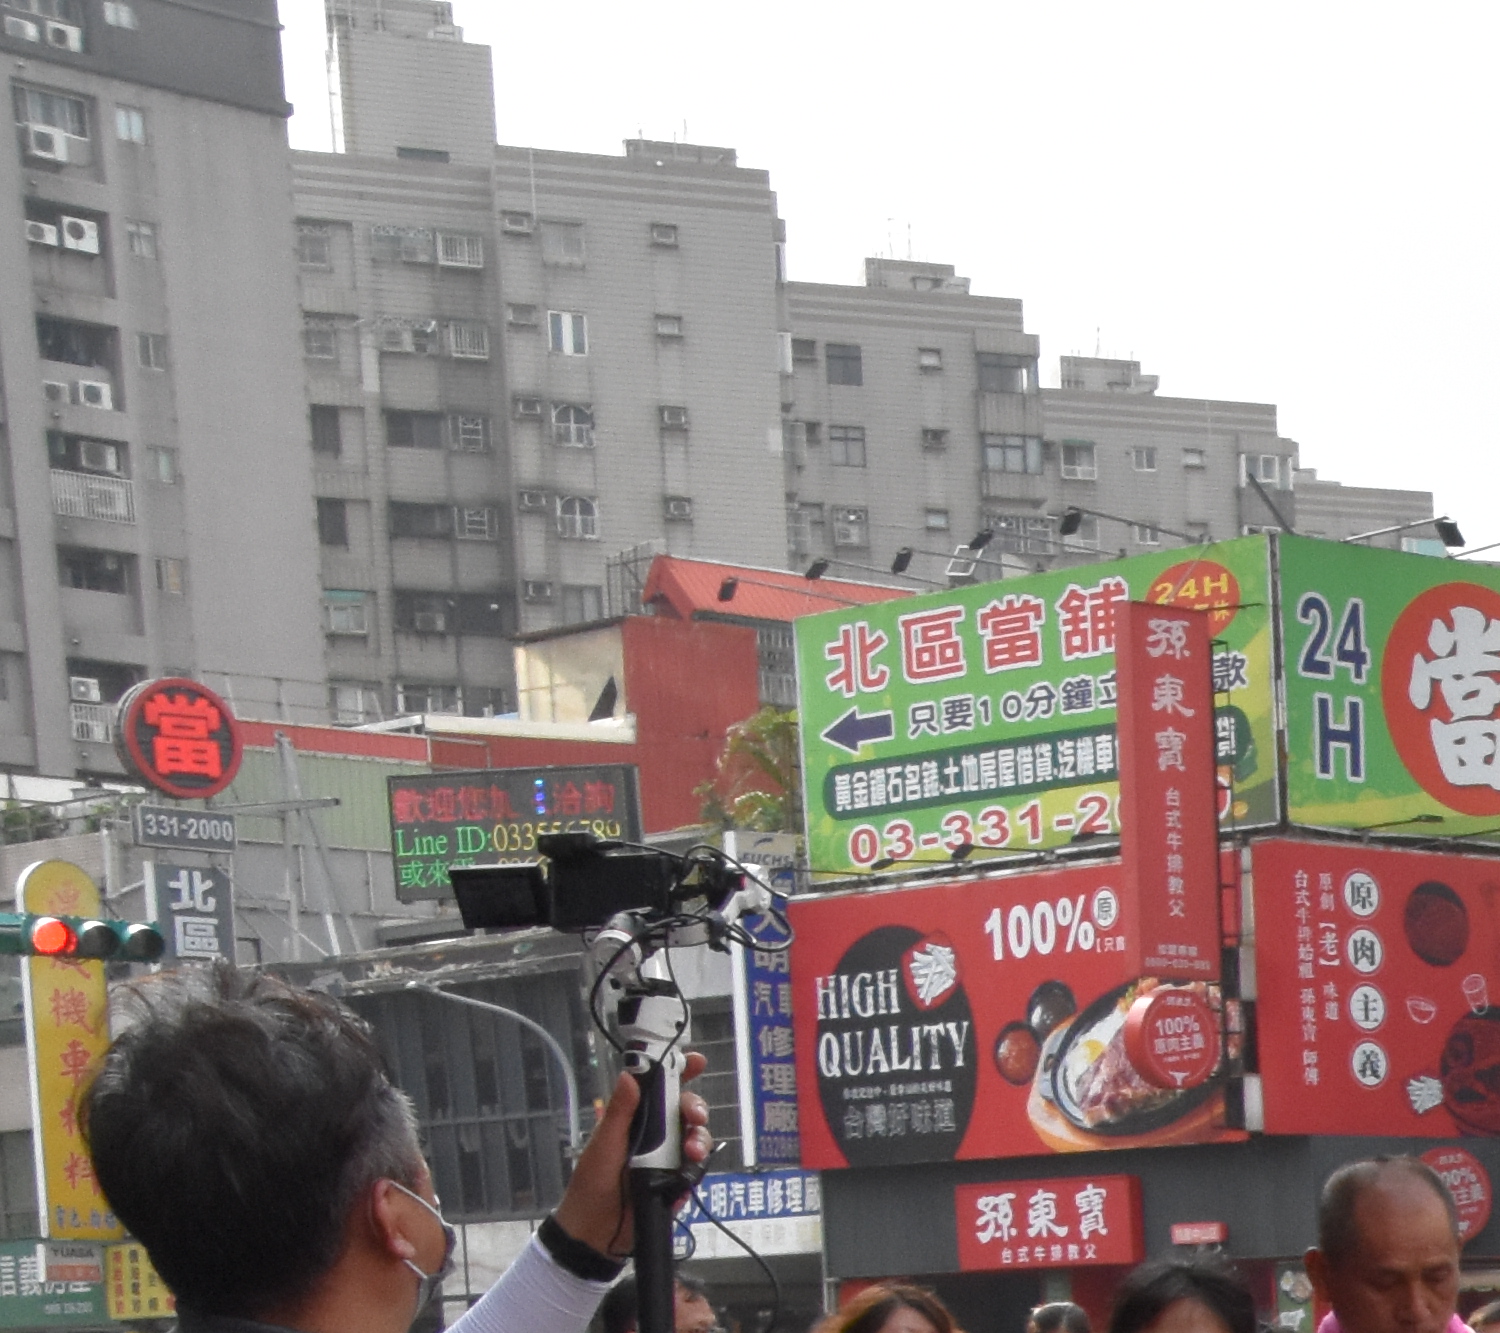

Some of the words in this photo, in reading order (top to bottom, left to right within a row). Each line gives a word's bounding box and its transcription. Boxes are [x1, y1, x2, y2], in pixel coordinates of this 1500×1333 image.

[1154, 573, 1229, 606] 24H
[1299, 592, 1371, 682] 24
[143, 692, 222, 777] 當
[1316, 694, 1365, 783] H
[145, 813, 234, 843] 331-2000
[395, 826, 449, 857] Line
[168, 869, 222, 958] 北區
[985, 893, 1095, 961] 100%
[816, 967, 901, 1020] HIGH
[818, 1021, 970, 1078] QUALITY
[1155, 1015, 1200, 1036] 100%
